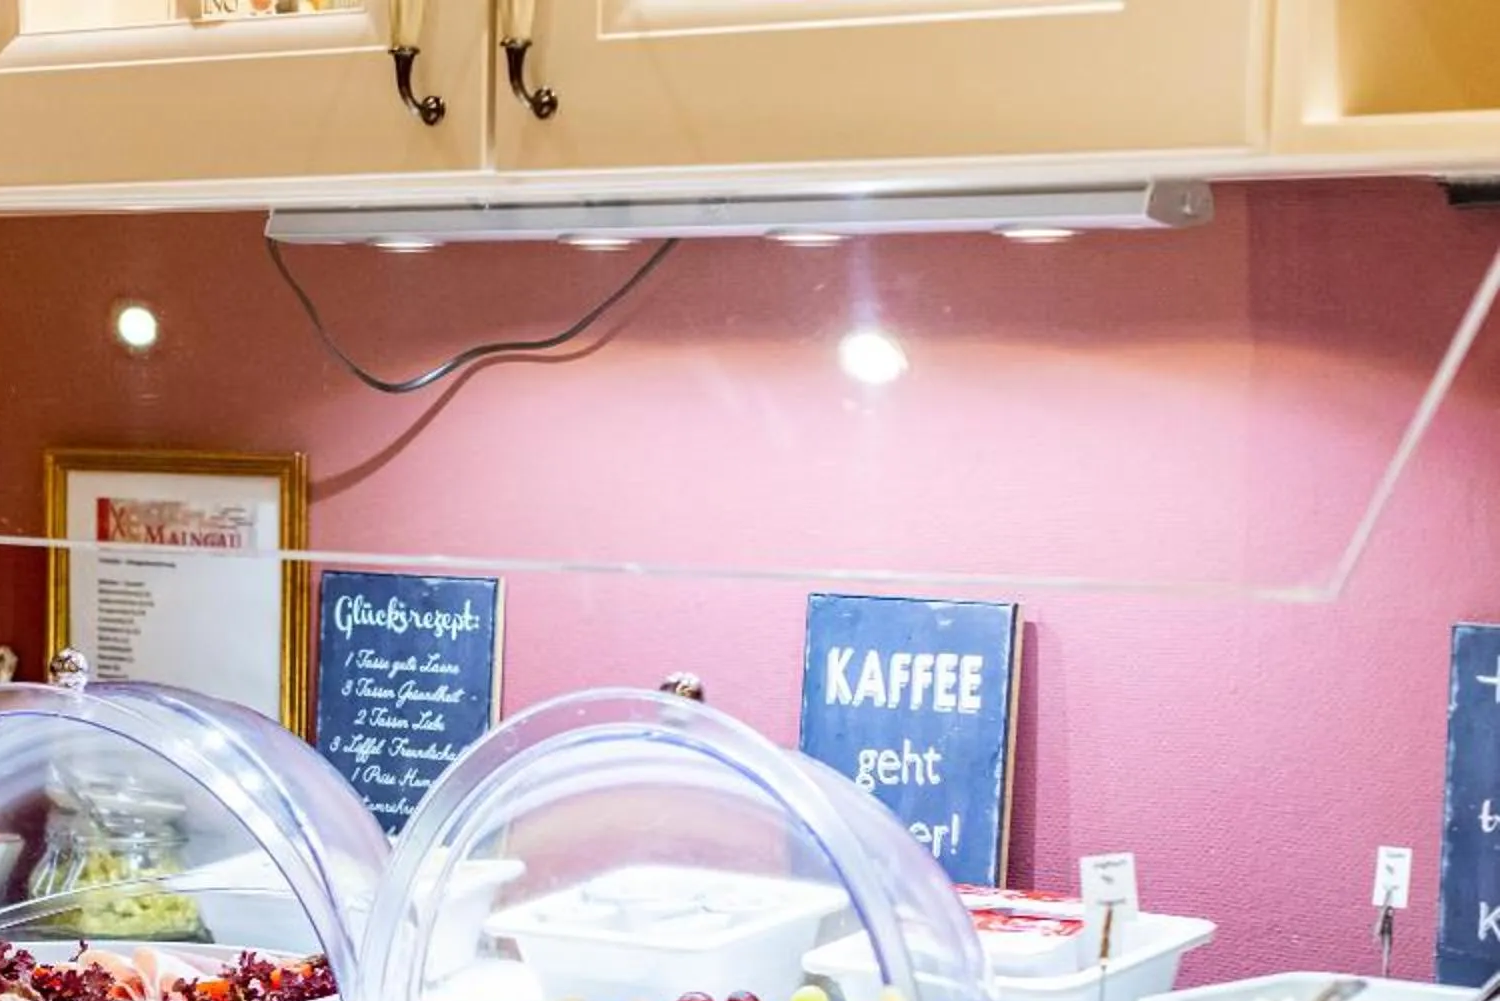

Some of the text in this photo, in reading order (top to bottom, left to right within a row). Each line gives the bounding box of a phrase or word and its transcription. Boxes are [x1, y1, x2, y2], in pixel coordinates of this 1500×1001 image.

[335, 594, 480, 641] Glücksrezept:
[355, 649, 389, 669] Tasse
[388, 655, 417, 679] gute
[419, 653, 461, 675] Laune
[356, 677, 396, 699] Tassen
[395, 680, 466, 708] Gesundheit
[825, 646, 984, 714] KAFFEE
[354, 707, 446, 731] 2 Tassen Liebe
[387, 737, 460, 762] Freundscha
[398, 767, 432, 787] Hum
[855, 738, 943, 793] geht
[909, 812, 960, 858] er!
